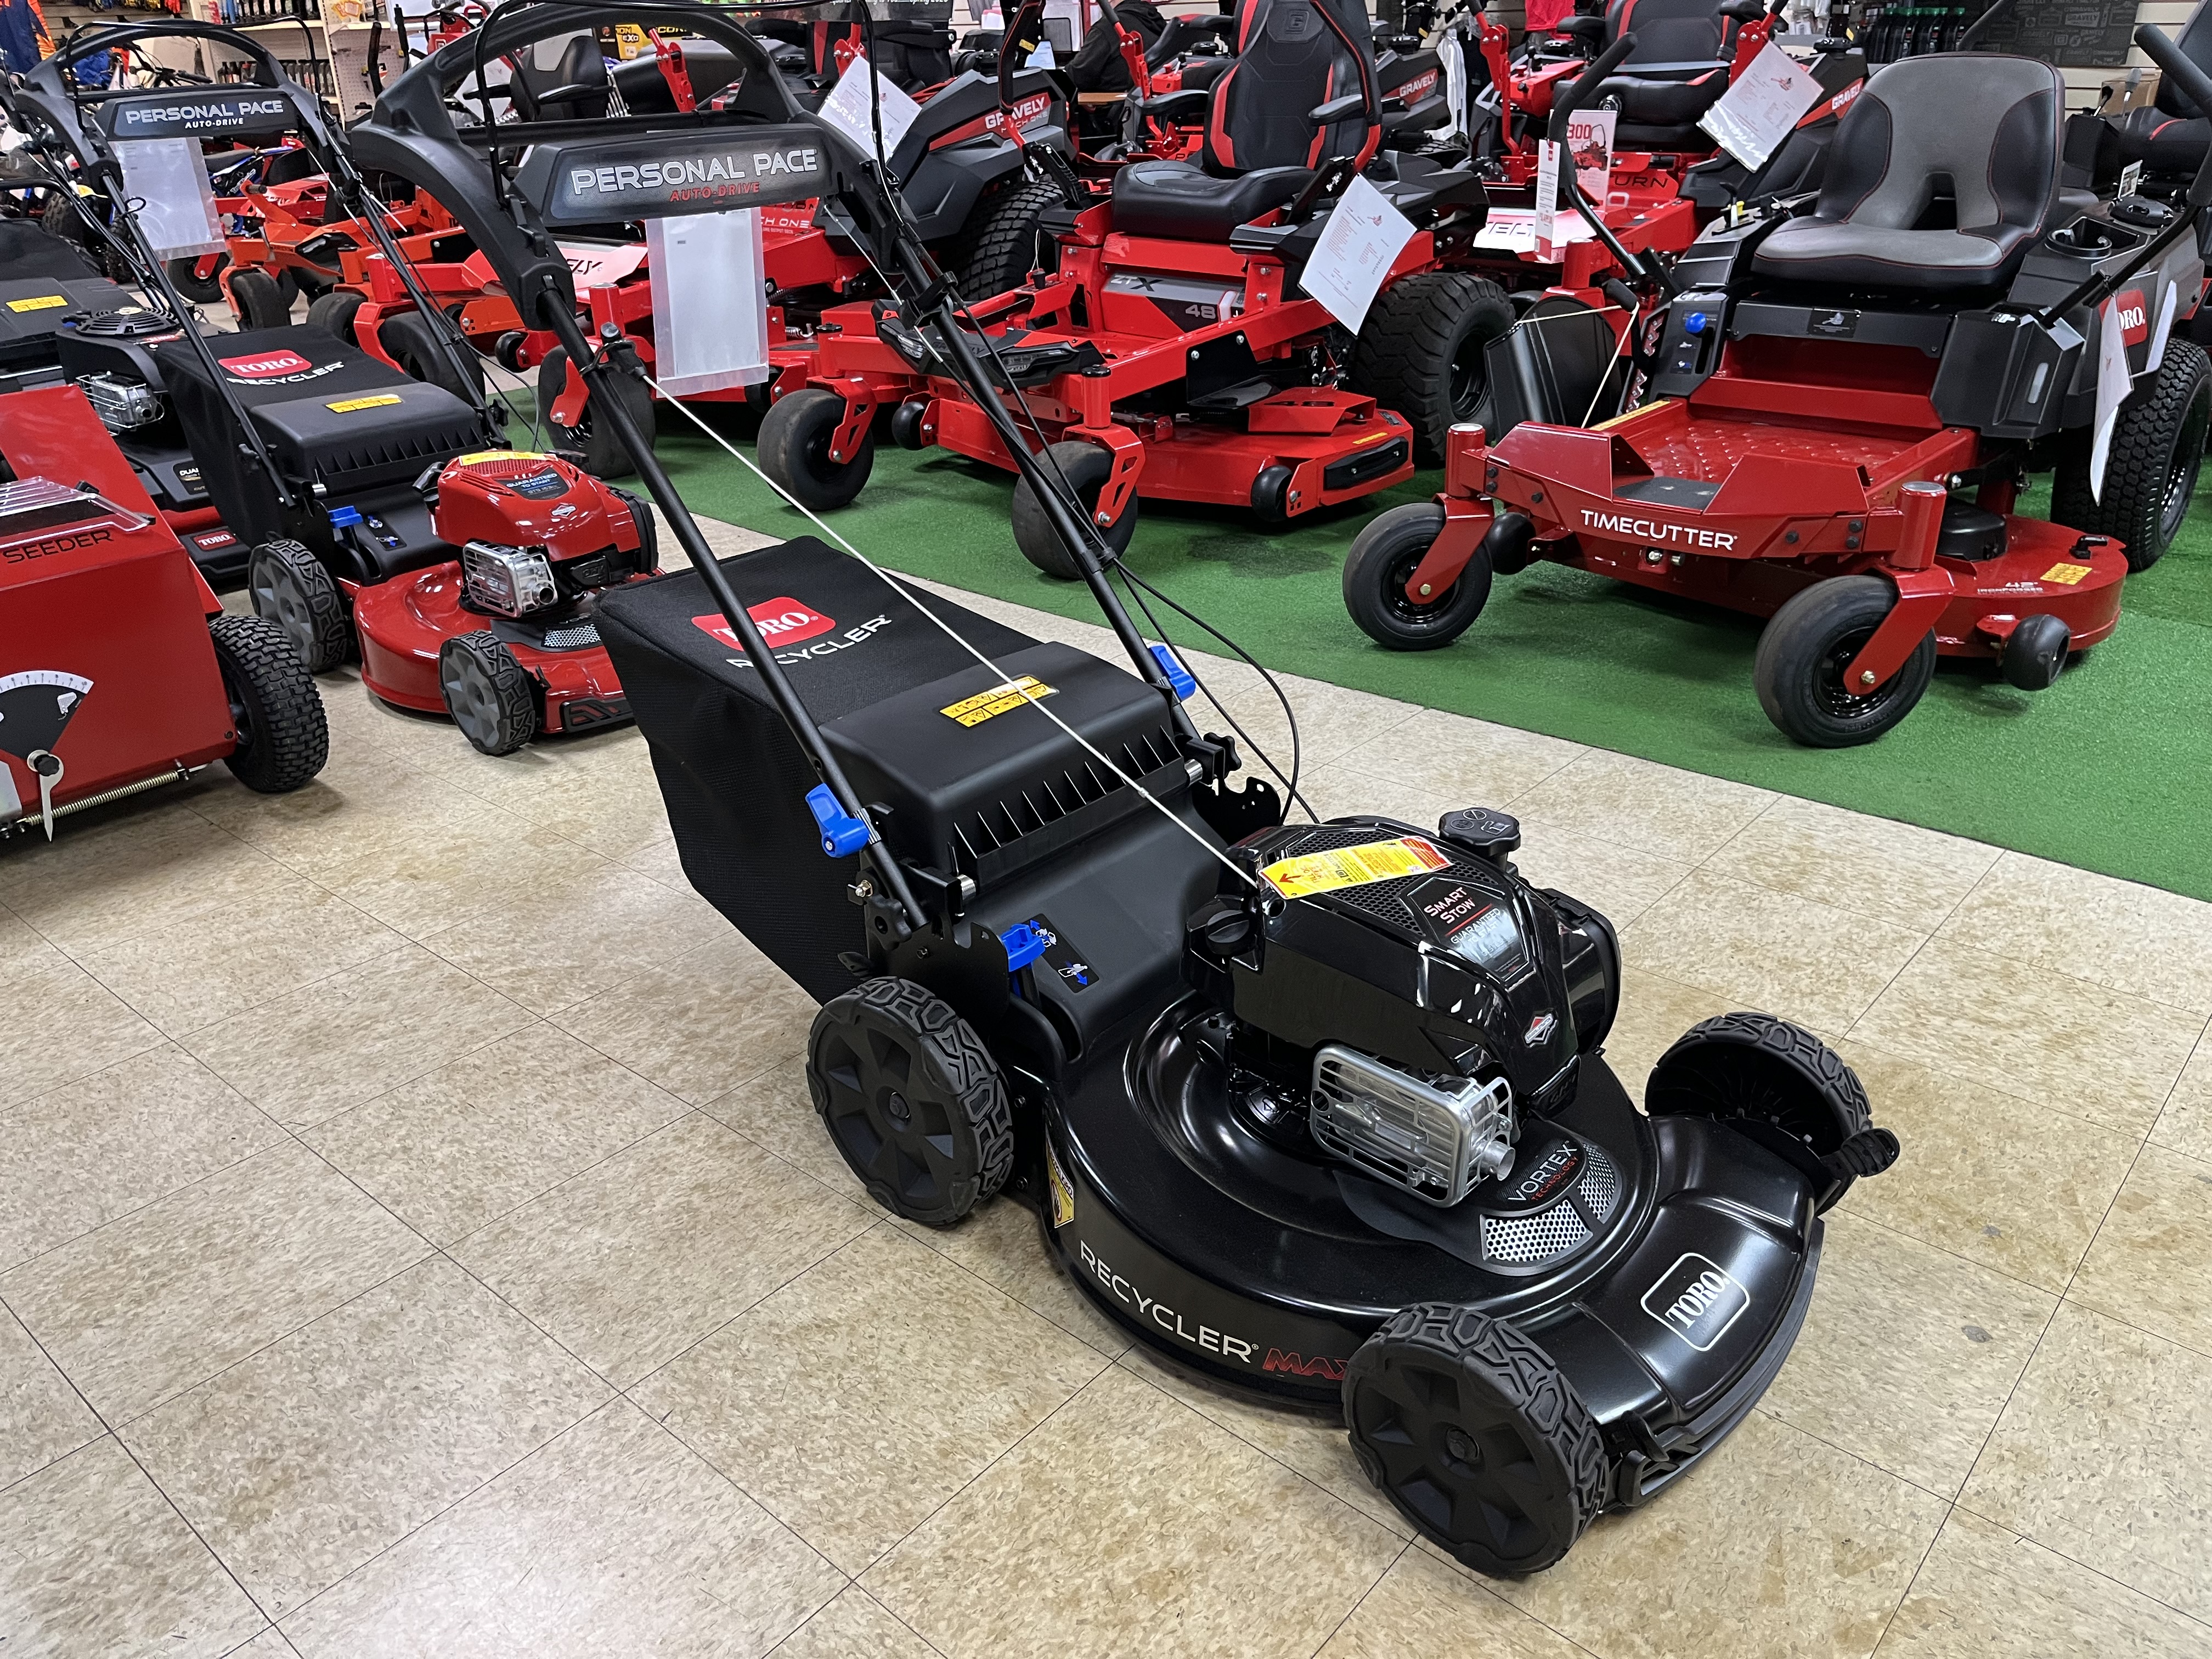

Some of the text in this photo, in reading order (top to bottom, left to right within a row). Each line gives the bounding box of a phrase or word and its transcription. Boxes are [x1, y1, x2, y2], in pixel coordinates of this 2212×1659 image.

[1400, 72, 1435, 97] GRAVELY
[125, 100, 284, 125] PERSONAL PACE
[184, 117, 244, 129] AUTO-DRIVE
[570, 149, 818, 195] PERSONAL PACE
[669, 180, 760, 202] AUTO-DRIVE
[779, 218, 810, 229] ONE
[1185, 304, 1216, 319] 48
[230, 358, 298, 373] TORO
[506, 473, 558, 488] GUARANTEED
[198, 534, 231, 546] TORO
[1581, 509, 1734, 551] TIMECUTTER
[2, 529, 114, 564] SEEDER
[713, 612, 810, 642] TRO
[726, 617, 893, 668] RCYCLER
[1424, 887, 1468, 917] SMART
[1440, 898, 1476, 924] STOW
[1451, 908, 1501, 944] GUARANTEED
[1507, 1144, 1578, 1201] VORTEX
[1531, 1156, 1579, 1201] TECHNOLOGY
[1079, 1239, 1251, 1363] RECYCLER
[1664, 1271, 1725, 1329] TORO
